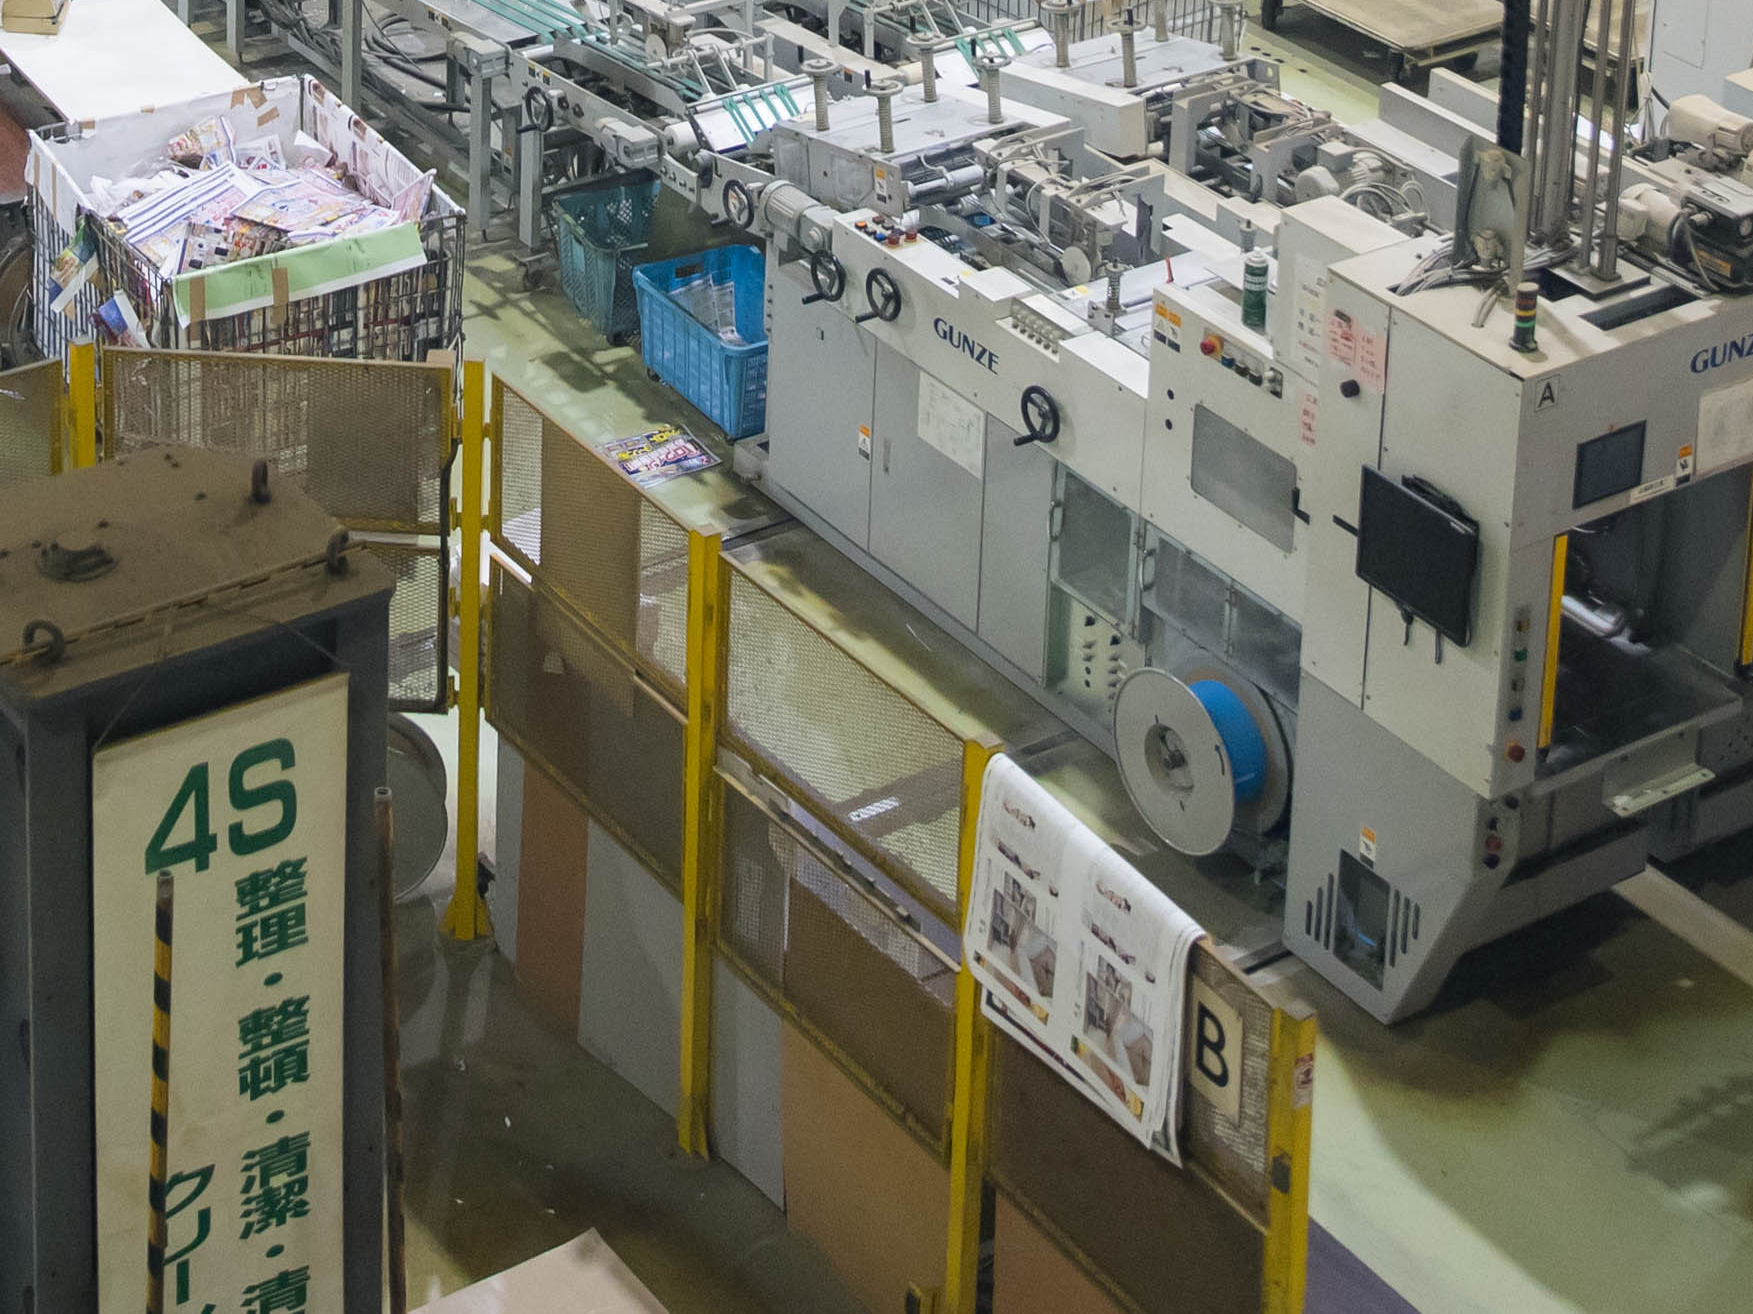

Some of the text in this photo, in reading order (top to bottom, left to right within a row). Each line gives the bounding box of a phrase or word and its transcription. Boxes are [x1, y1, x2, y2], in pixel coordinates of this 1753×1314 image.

[933, 317, 1000, 375] GUNZE
[1538, 382, 1555, 408] A
[145, 737, 298, 875] 4S
[1195, 1000, 1229, 1089] B
